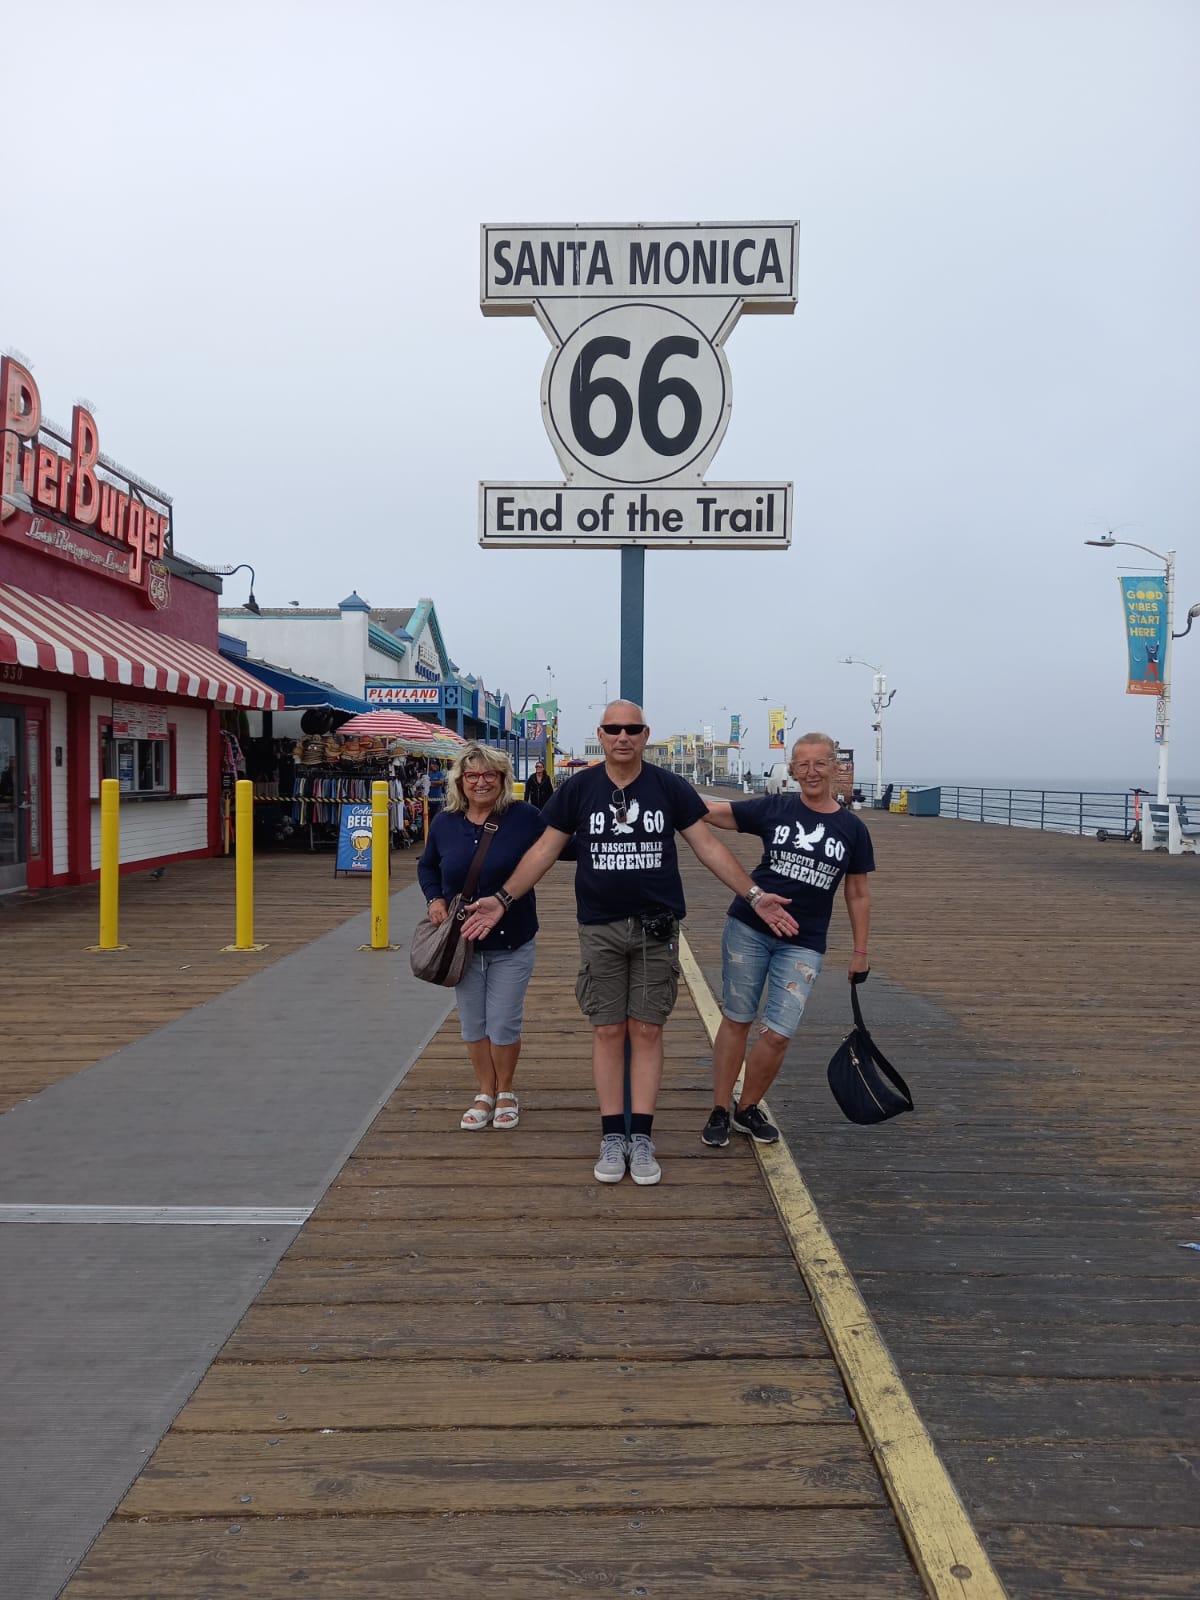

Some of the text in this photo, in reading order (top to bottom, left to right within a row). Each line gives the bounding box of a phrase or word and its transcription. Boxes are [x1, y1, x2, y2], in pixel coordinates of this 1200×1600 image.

[493, 238, 784, 286] SANTA MONICA
[569, 335, 702, 457] 66
[71, 404, 169, 584] Burger
[496, 492, 775, 532] End of the Trail
[1126, 590, 1163, 600] GOOD
[1128, 602, 1158, 612] VIBES
[1129, 614, 1160, 625] START
[1129, 627, 1157, 637] HERE
[368, 688, 438, 699] PLAYLAND
[346, 815, 373, 829] BEER
[589, 809, 665, 835] 19 60
[590, 841, 663, 853] LA NASCITA DELLE
[772, 824, 846, 862] 19 60
[591, 852, 662, 870] LEGGENDE
[770, 849, 778, 860] LA
[780, 850, 815, 869] NASCITA
[769, 859, 834, 891] LEGGENDE
